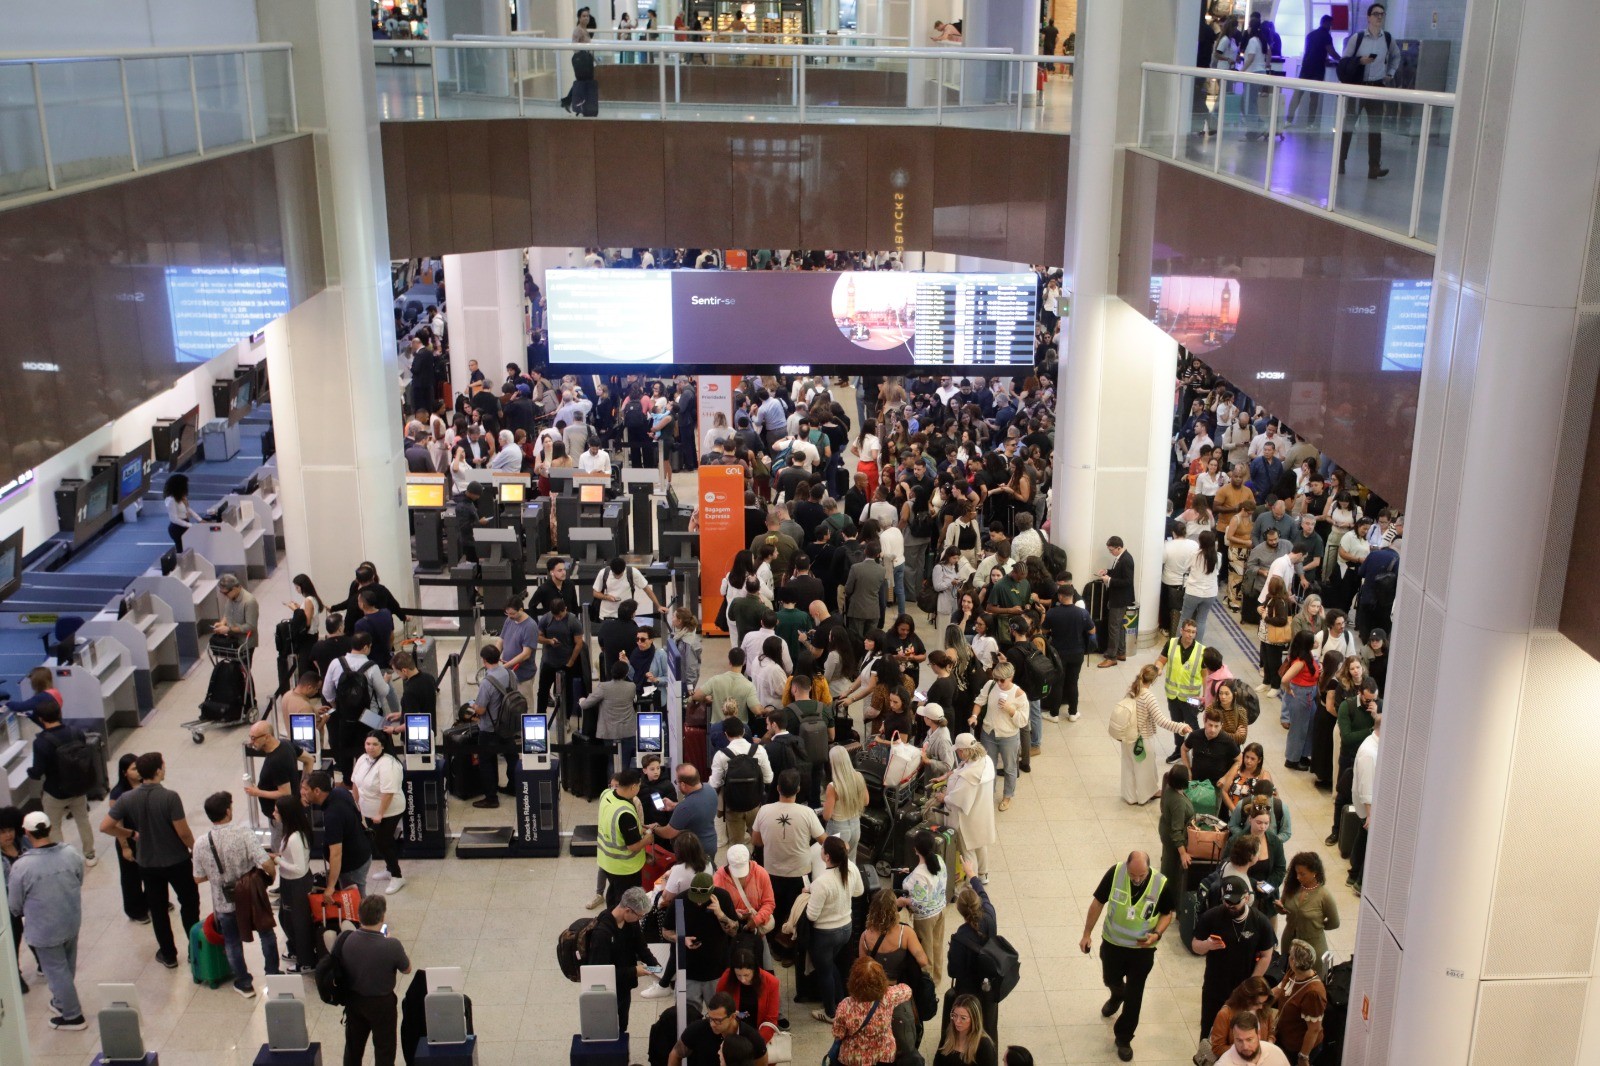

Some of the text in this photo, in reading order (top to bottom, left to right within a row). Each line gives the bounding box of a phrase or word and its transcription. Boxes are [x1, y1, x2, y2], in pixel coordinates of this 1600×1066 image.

[691, 296, 736, 305] Sentir-se
[170, 438, 180, 454] 13
[142, 458, 152, 476] 12
[77, 505, 88, 522] 11
[406, 781, 416, 842] Check-in Rápido Azul
